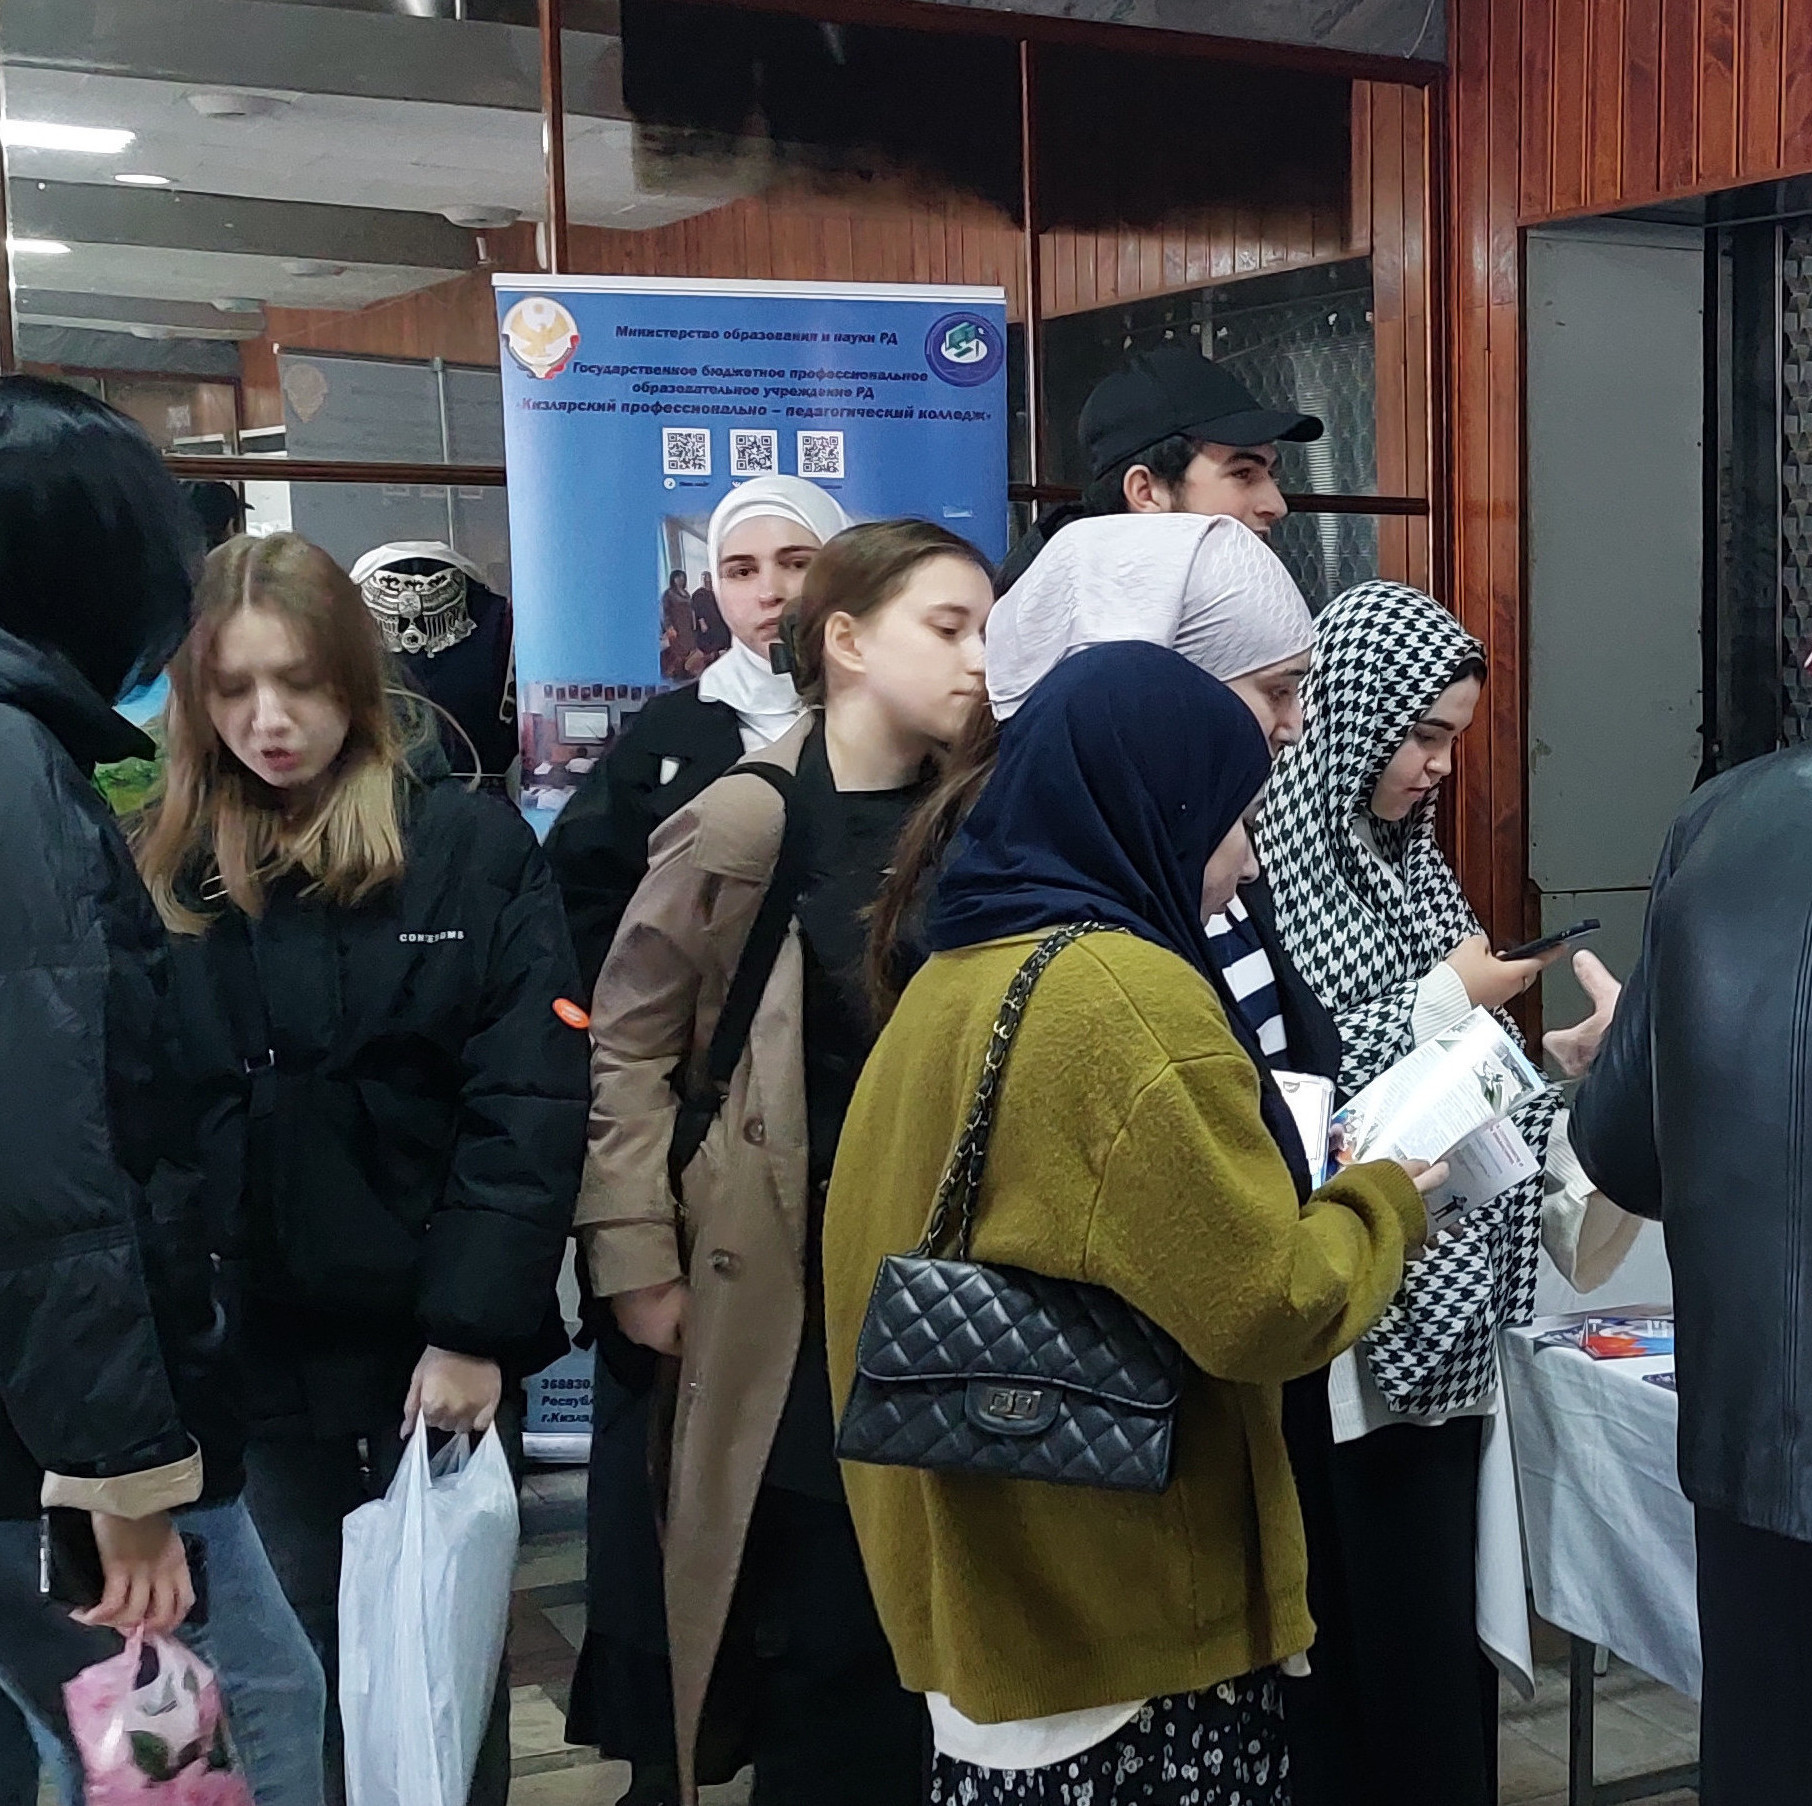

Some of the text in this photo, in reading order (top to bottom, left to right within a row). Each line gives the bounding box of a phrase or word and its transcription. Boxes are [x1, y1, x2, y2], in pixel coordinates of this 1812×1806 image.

[615, 325, 720, 341] Министерство
[723, 329, 818, 343] образования
[834, 333, 875, 344] науки
[880, 332, 898, 345] РД
[573, 361, 929, 382] Государственное бюджетное профессиональное
[632, 381, 875, 400] образовательное учреждение РД
[621, 401, 767, 416] профессионально
[785, 405, 914, 419] педагогический
